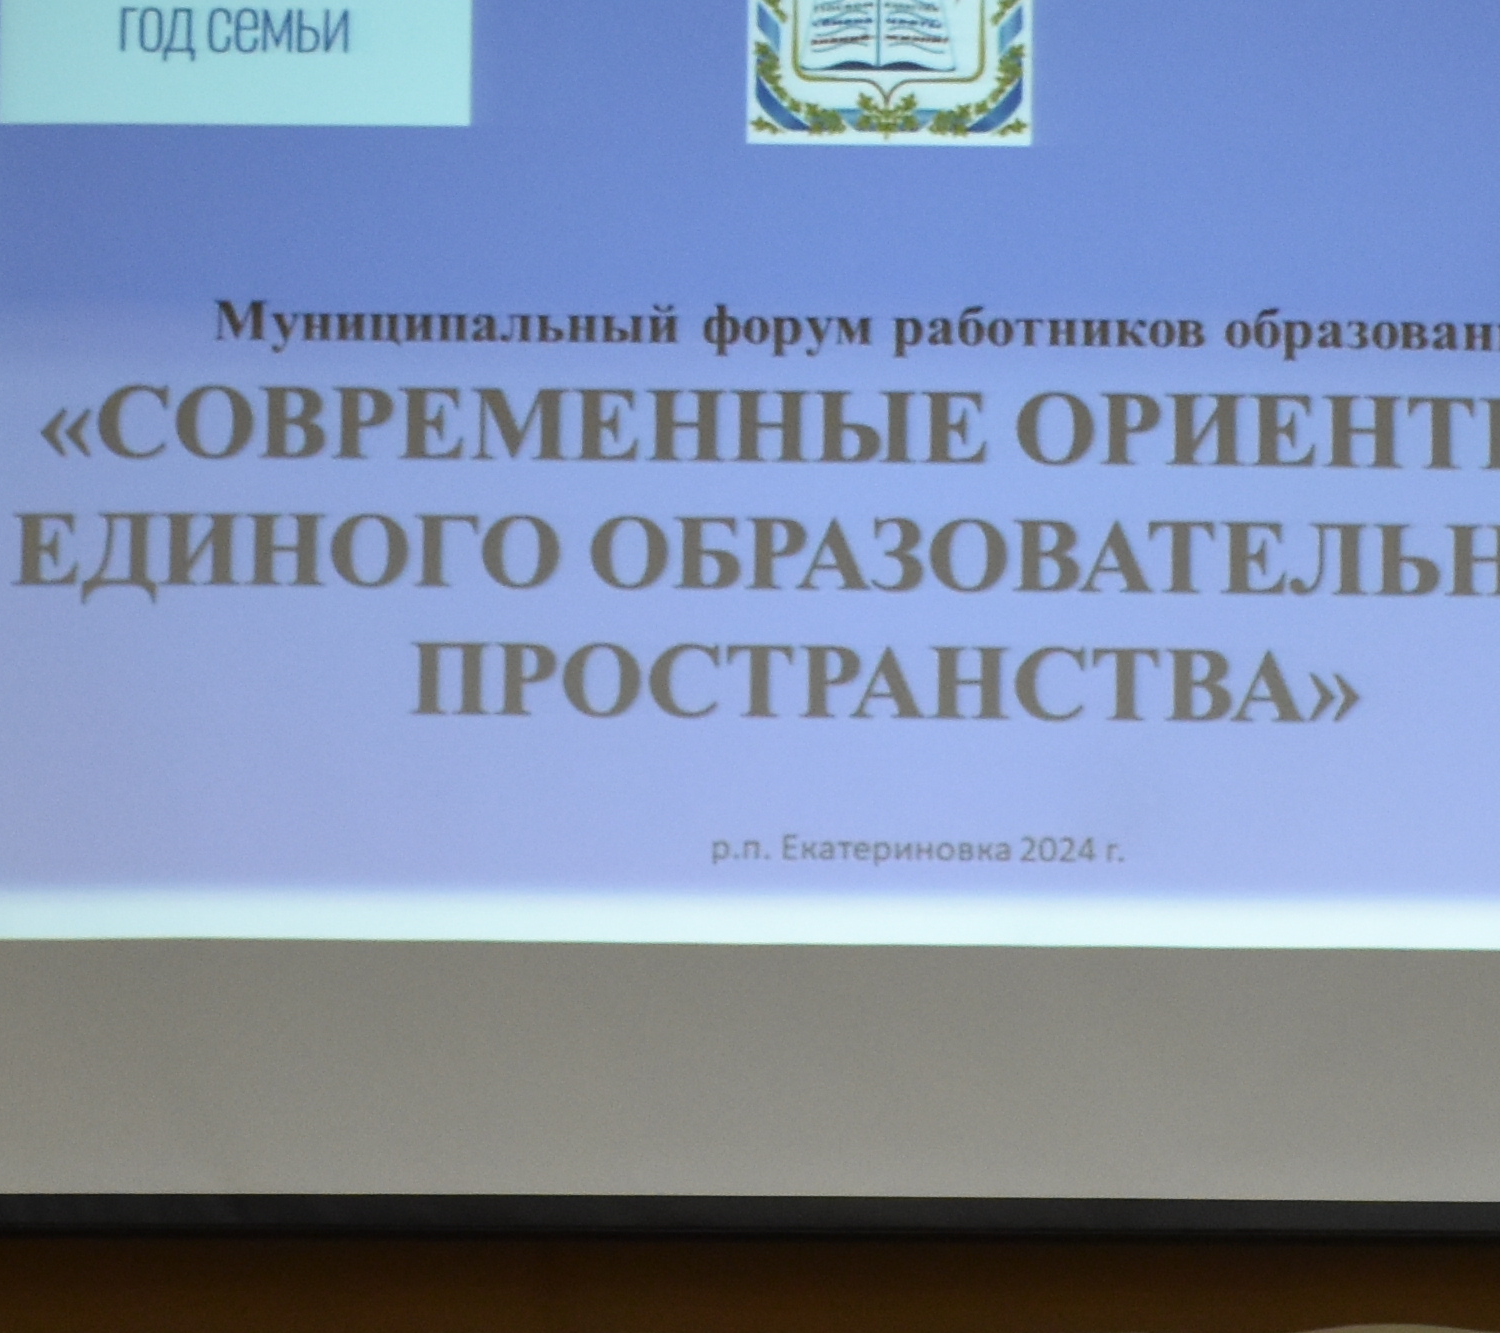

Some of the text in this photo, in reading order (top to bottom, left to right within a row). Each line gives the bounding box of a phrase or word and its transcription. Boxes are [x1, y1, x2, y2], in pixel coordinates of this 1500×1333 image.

[214, 299, 679, 353] Муниципальный
[703, 303, 872, 356] форум
[894, 305, 1205, 356] работников
[40, 383, 988, 465] «СОВРЕМЕННЫЕ
[12, 512, 562, 605] ЕДИНОГО
[411, 640, 1361, 723] ПРОСТРАНСТВА»
[711, 833, 1126, 867] р.п. Екатериновка 2024 г.
